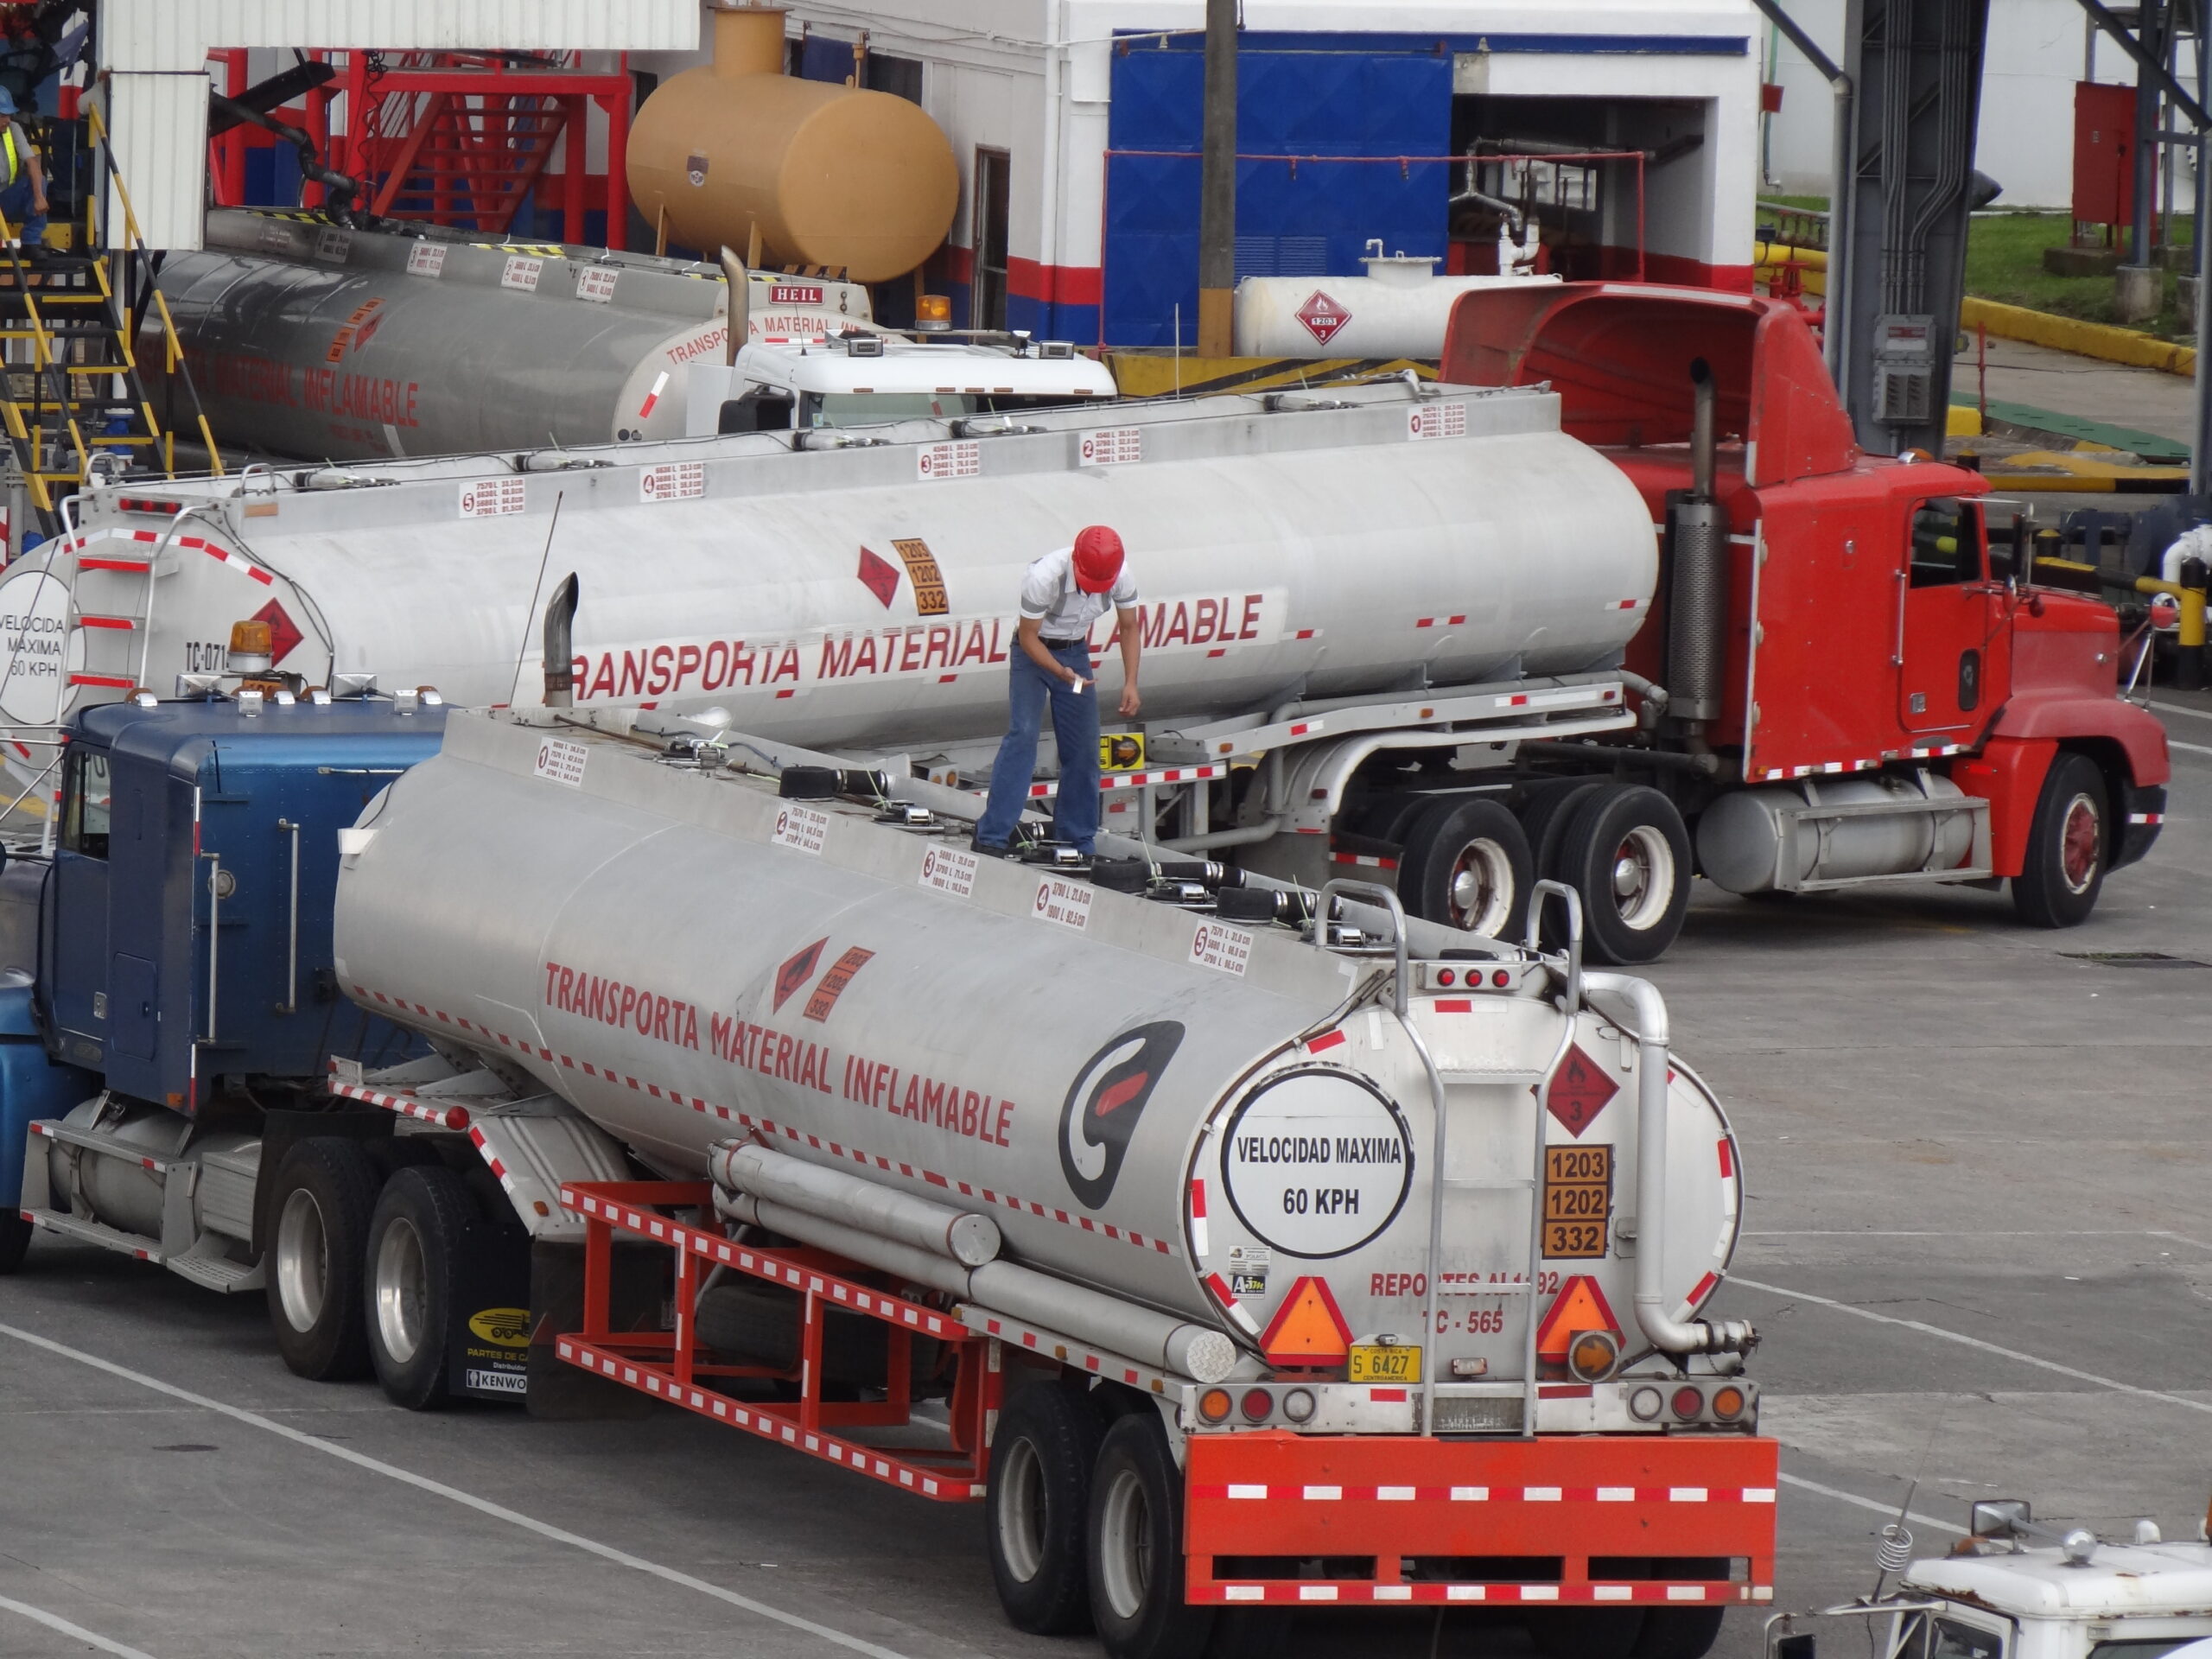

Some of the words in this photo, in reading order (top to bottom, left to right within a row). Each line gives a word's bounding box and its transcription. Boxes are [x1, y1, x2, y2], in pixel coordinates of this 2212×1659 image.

[778, 288, 817, 302] HEIL
[666, 320, 760, 365] TRANSPOA
[766, 316, 829, 334] MATERIAL
[304, 365, 419, 428] INFLAMABLE
[899, 542, 931, 559] 1203
[912, 564, 941, 583] 1202
[919, 590, 946, 610] 332
[0, 615, 66, 633] VELOCIDA
[8, 637, 61, 656] MAXIMA
[186, 641, 230, 672] TC-071
[543, 639, 799, 703] RANSPORTA
[817, 617, 1009, 680] MATERIAL
[1086, 594, 1263, 653] LAMABLE
[11, 660, 25, 676] 60
[29, 661, 57, 677] KPH
[1211, 925, 1224, 937] 7570
[810, 998, 830, 1017] 332
[546, 962, 699, 1052] TRANSPORTA
[711, 1011, 833, 1095] MATERIAL
[843, 1054, 1016, 1147] INFLAMABLE
[1569, 1100, 1583, 1122] 3
[1237, 1136, 1332, 1164] VELOCIDAD
[1335, 1136, 1402, 1164] MAXIMA
[1551, 1152, 1605, 1178] 1203
[1283, 1188, 1308, 1215] 60
[1315, 1188, 1360, 1215] KPH
[1550, 1189, 1605, 1215] 1202
[1551, 1225, 1599, 1251] 332
[1370, 1272, 1480, 1297] REPOTES
[1467, 1310, 1503, 1333] 565
[467, 1348, 503, 1360] PARTES
[505, 1352, 517, 1361] DE
[1353, 1355, 1363, 1374] S
[1372, 1355, 1410, 1375] 6427
[481, 1375, 527, 1390] KENWO
